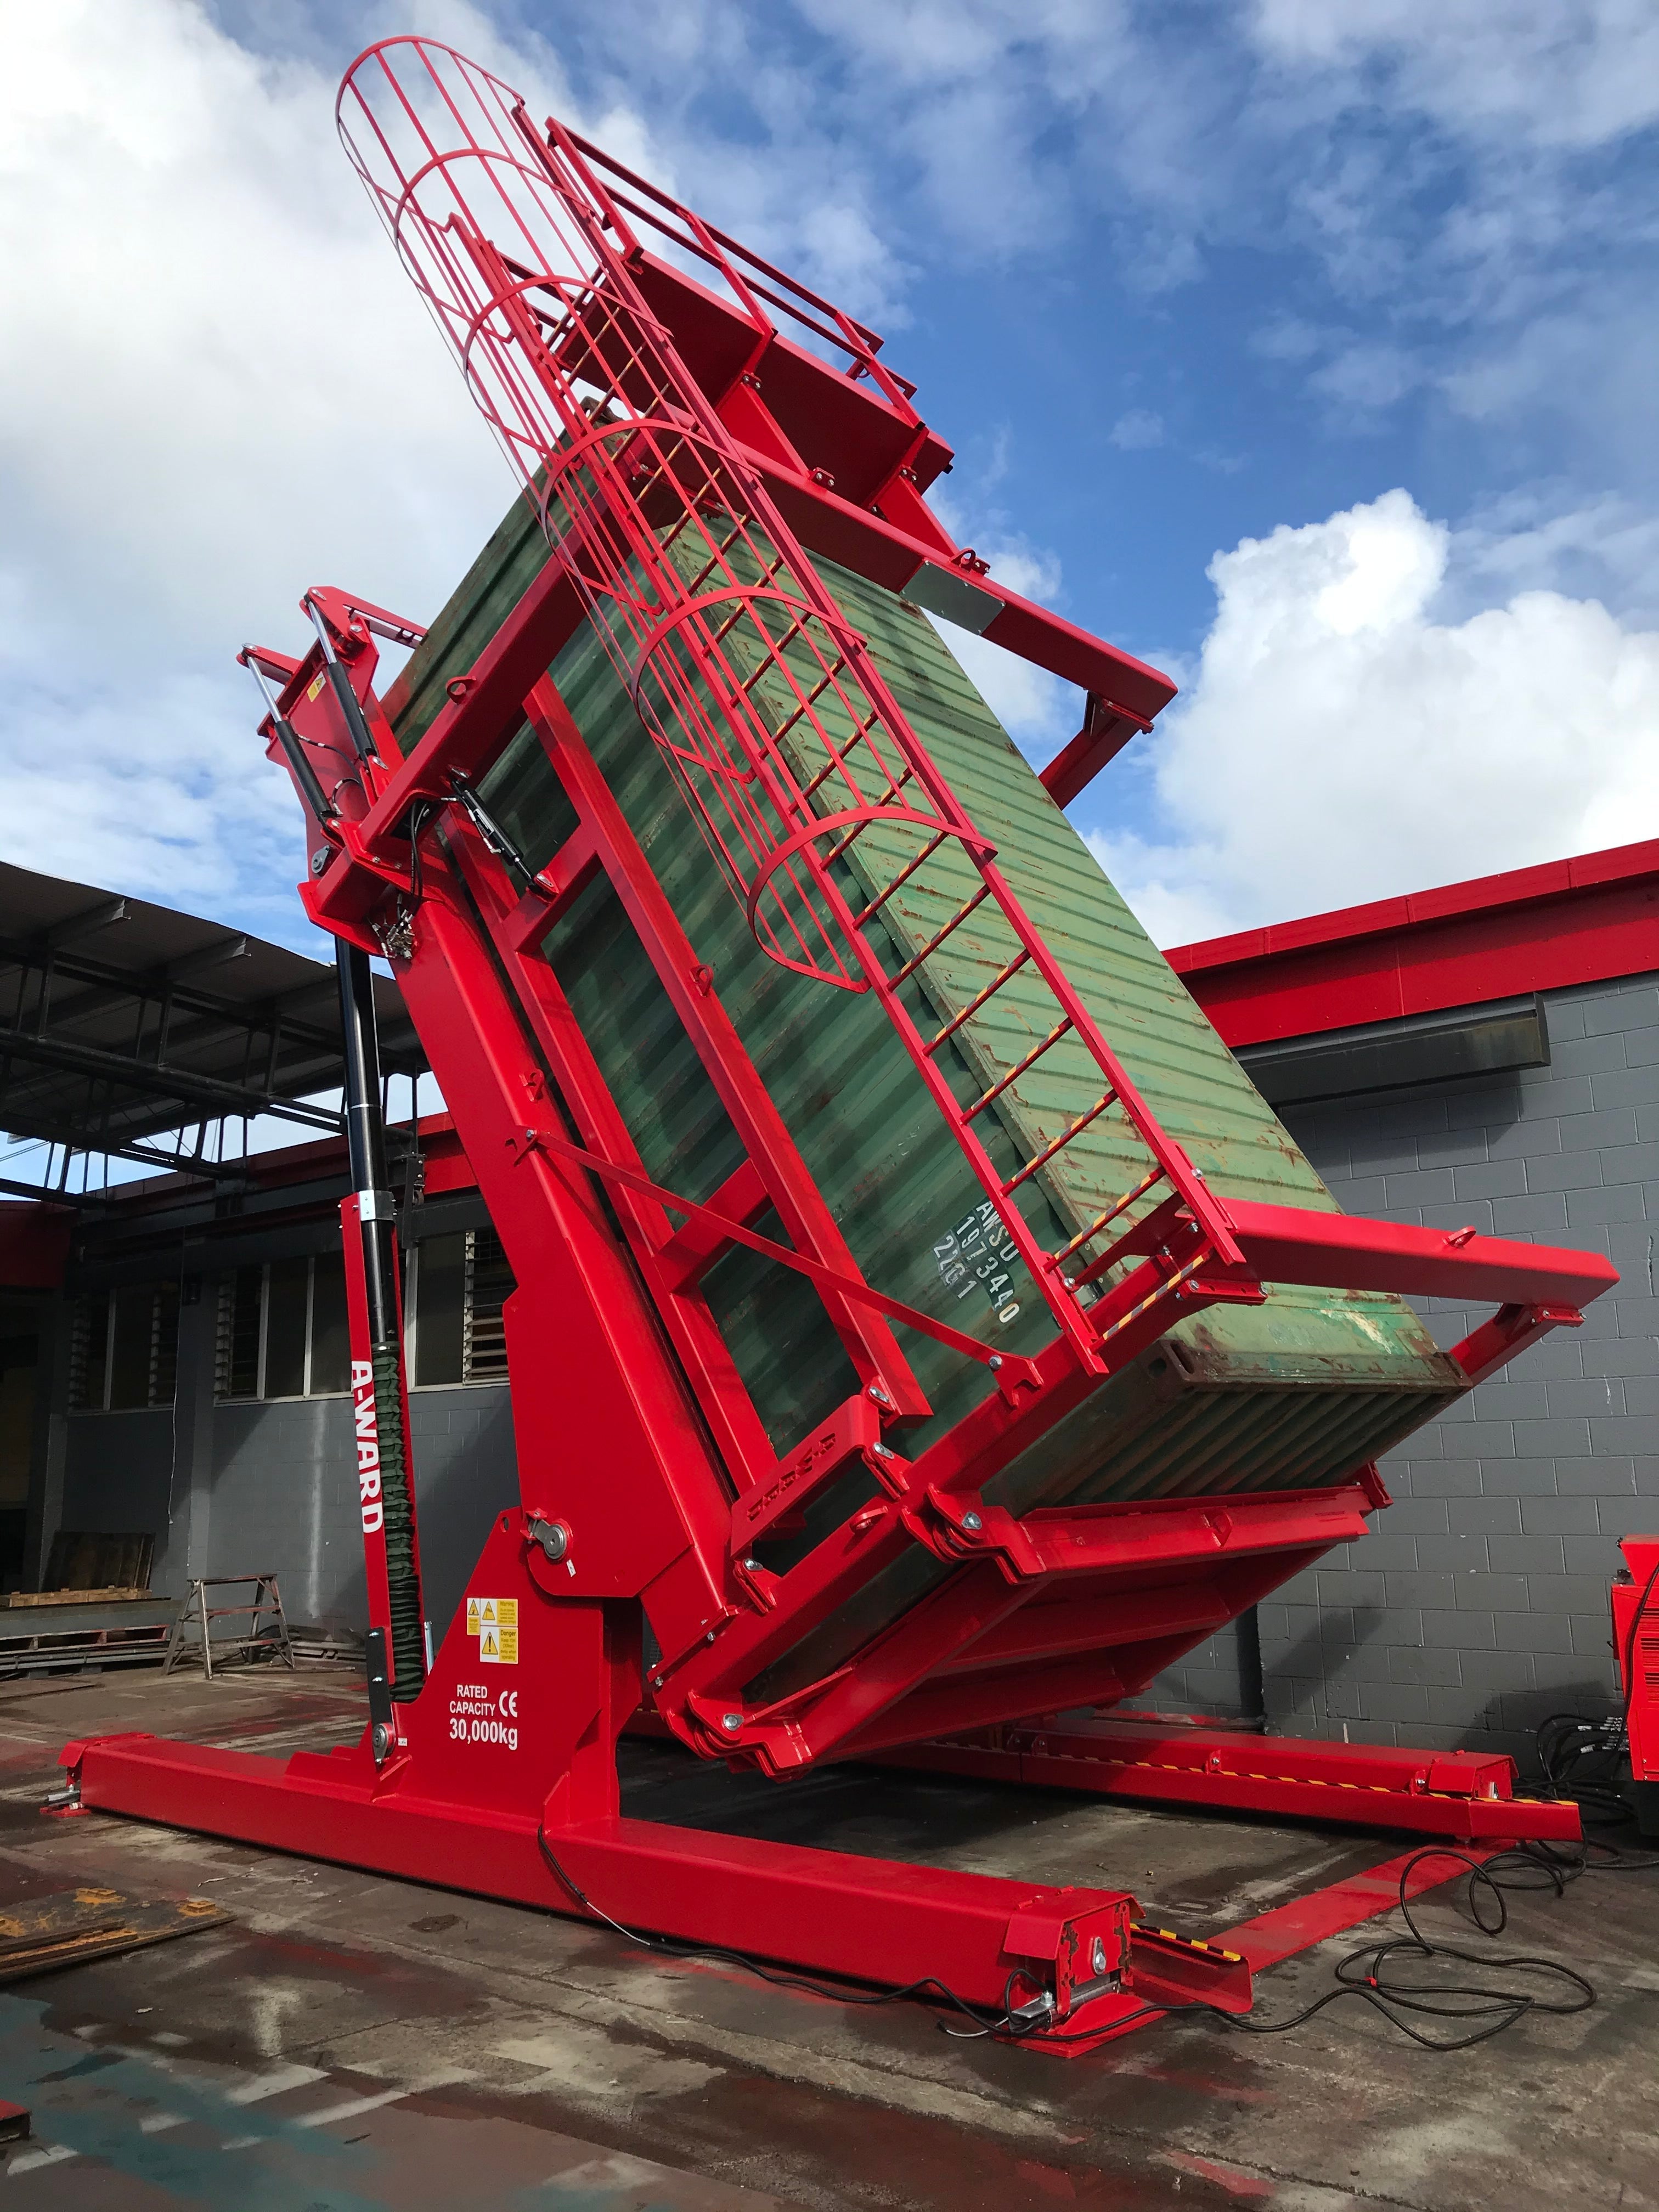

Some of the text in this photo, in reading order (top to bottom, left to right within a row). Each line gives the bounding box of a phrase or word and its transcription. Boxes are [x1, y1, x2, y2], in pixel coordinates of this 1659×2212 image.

[352, 1361, 383, 1533] A-WARD
[457, 1685, 488, 1699] RATED
[499, 1691, 518, 1717] CE
[449, 1701, 495, 1716] CAPACITY
[449, 1718, 518, 1750] 30,000kg
